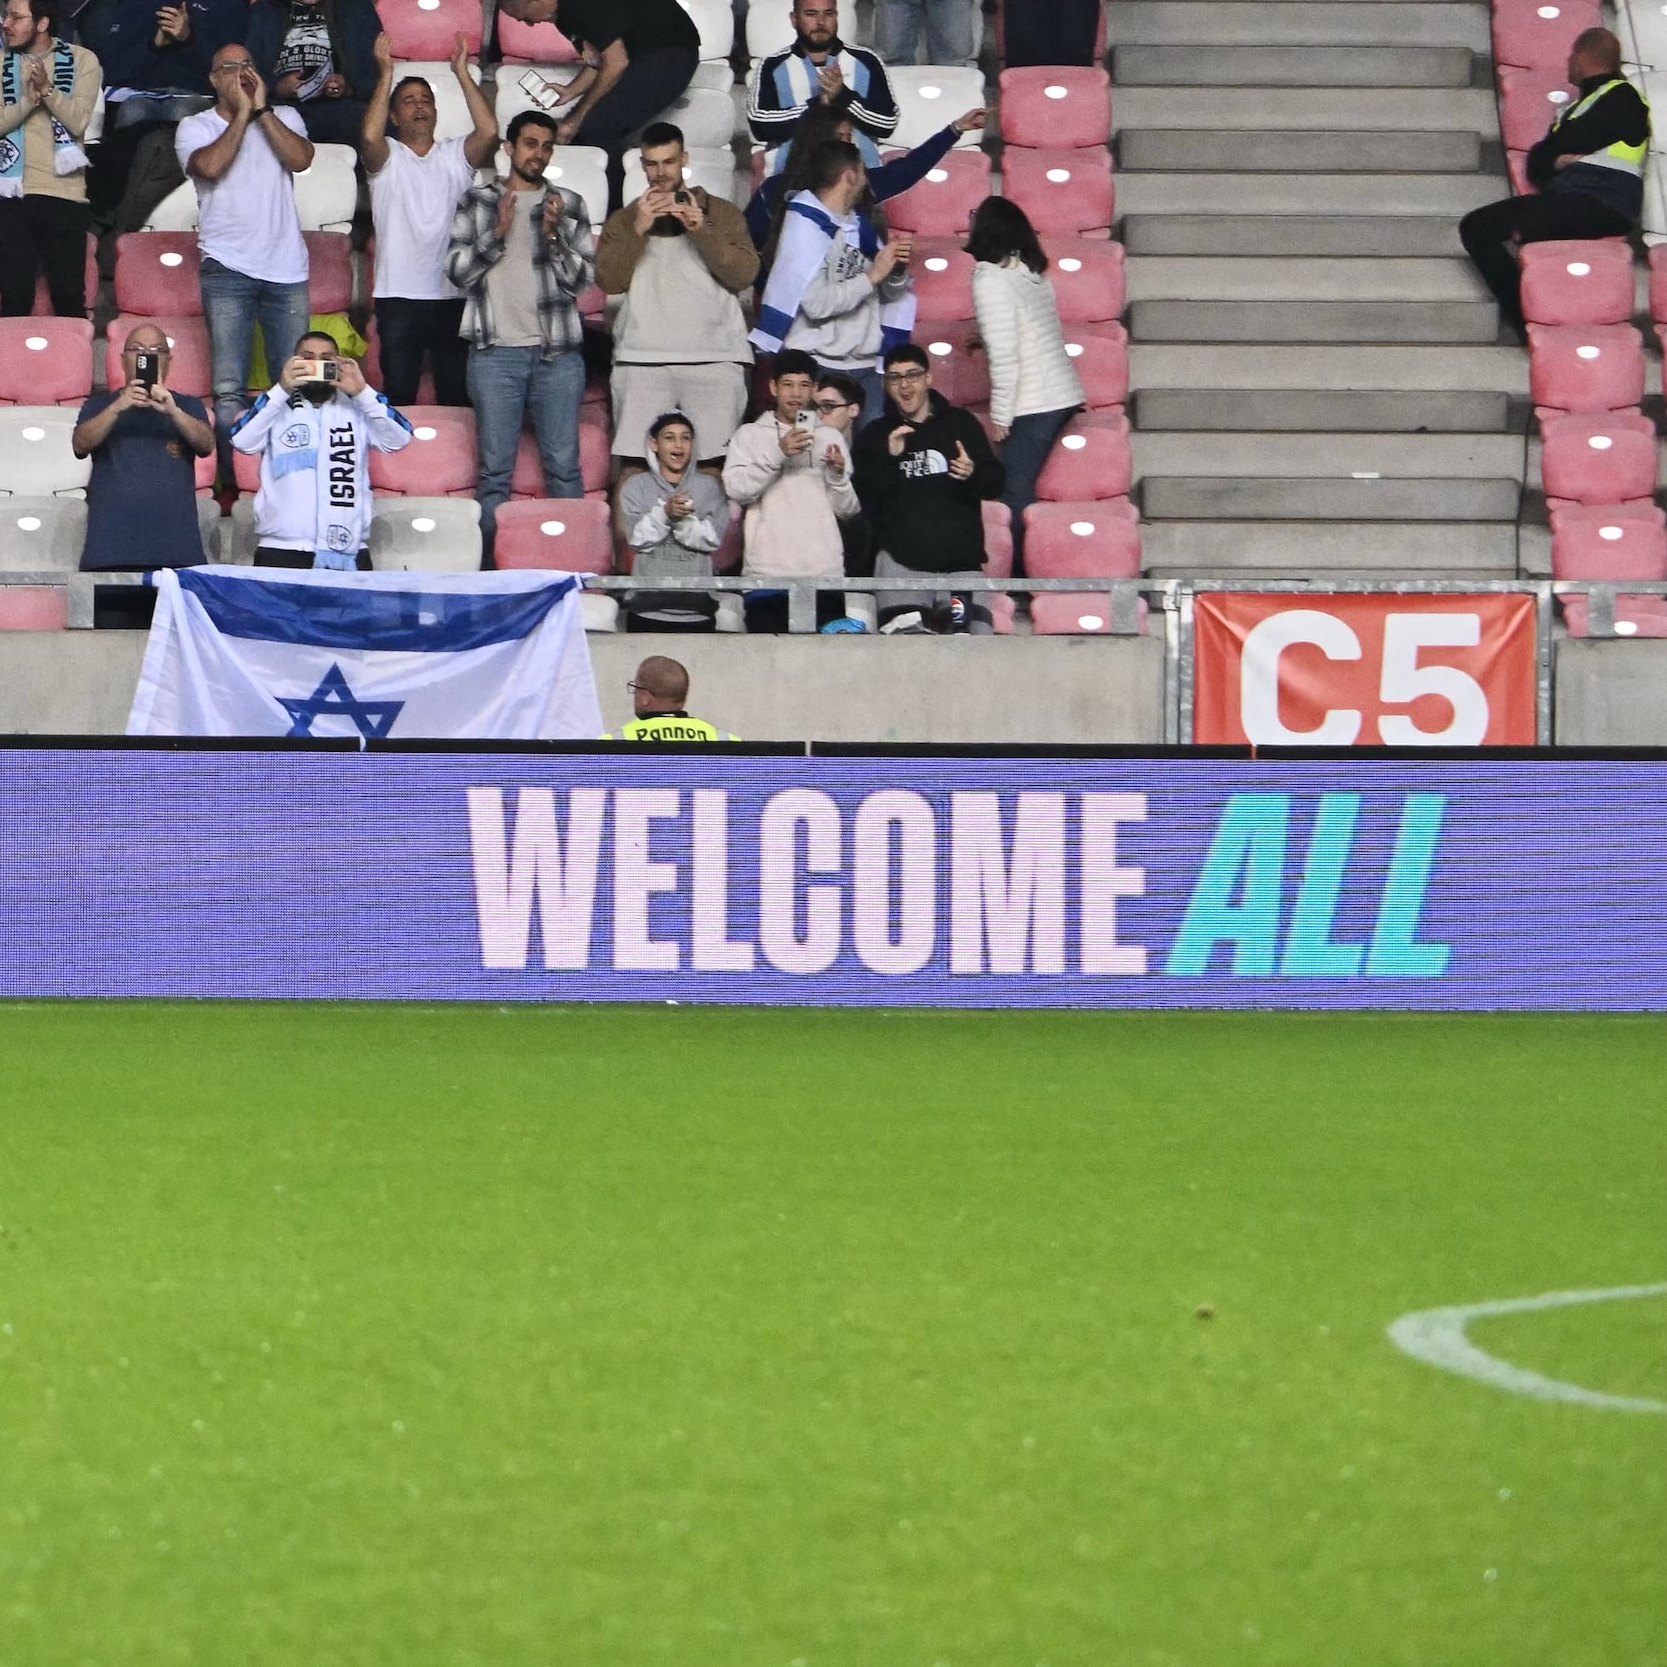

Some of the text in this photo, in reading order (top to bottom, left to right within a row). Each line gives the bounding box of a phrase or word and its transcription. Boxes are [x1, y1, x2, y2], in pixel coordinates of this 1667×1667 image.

[329, 421, 355, 508] ISRAEL
[1240, 609, 1489, 745] C5
[636, 726, 708, 741] Pannon
[466, 787, 1453, 977] WELCOME ALL
